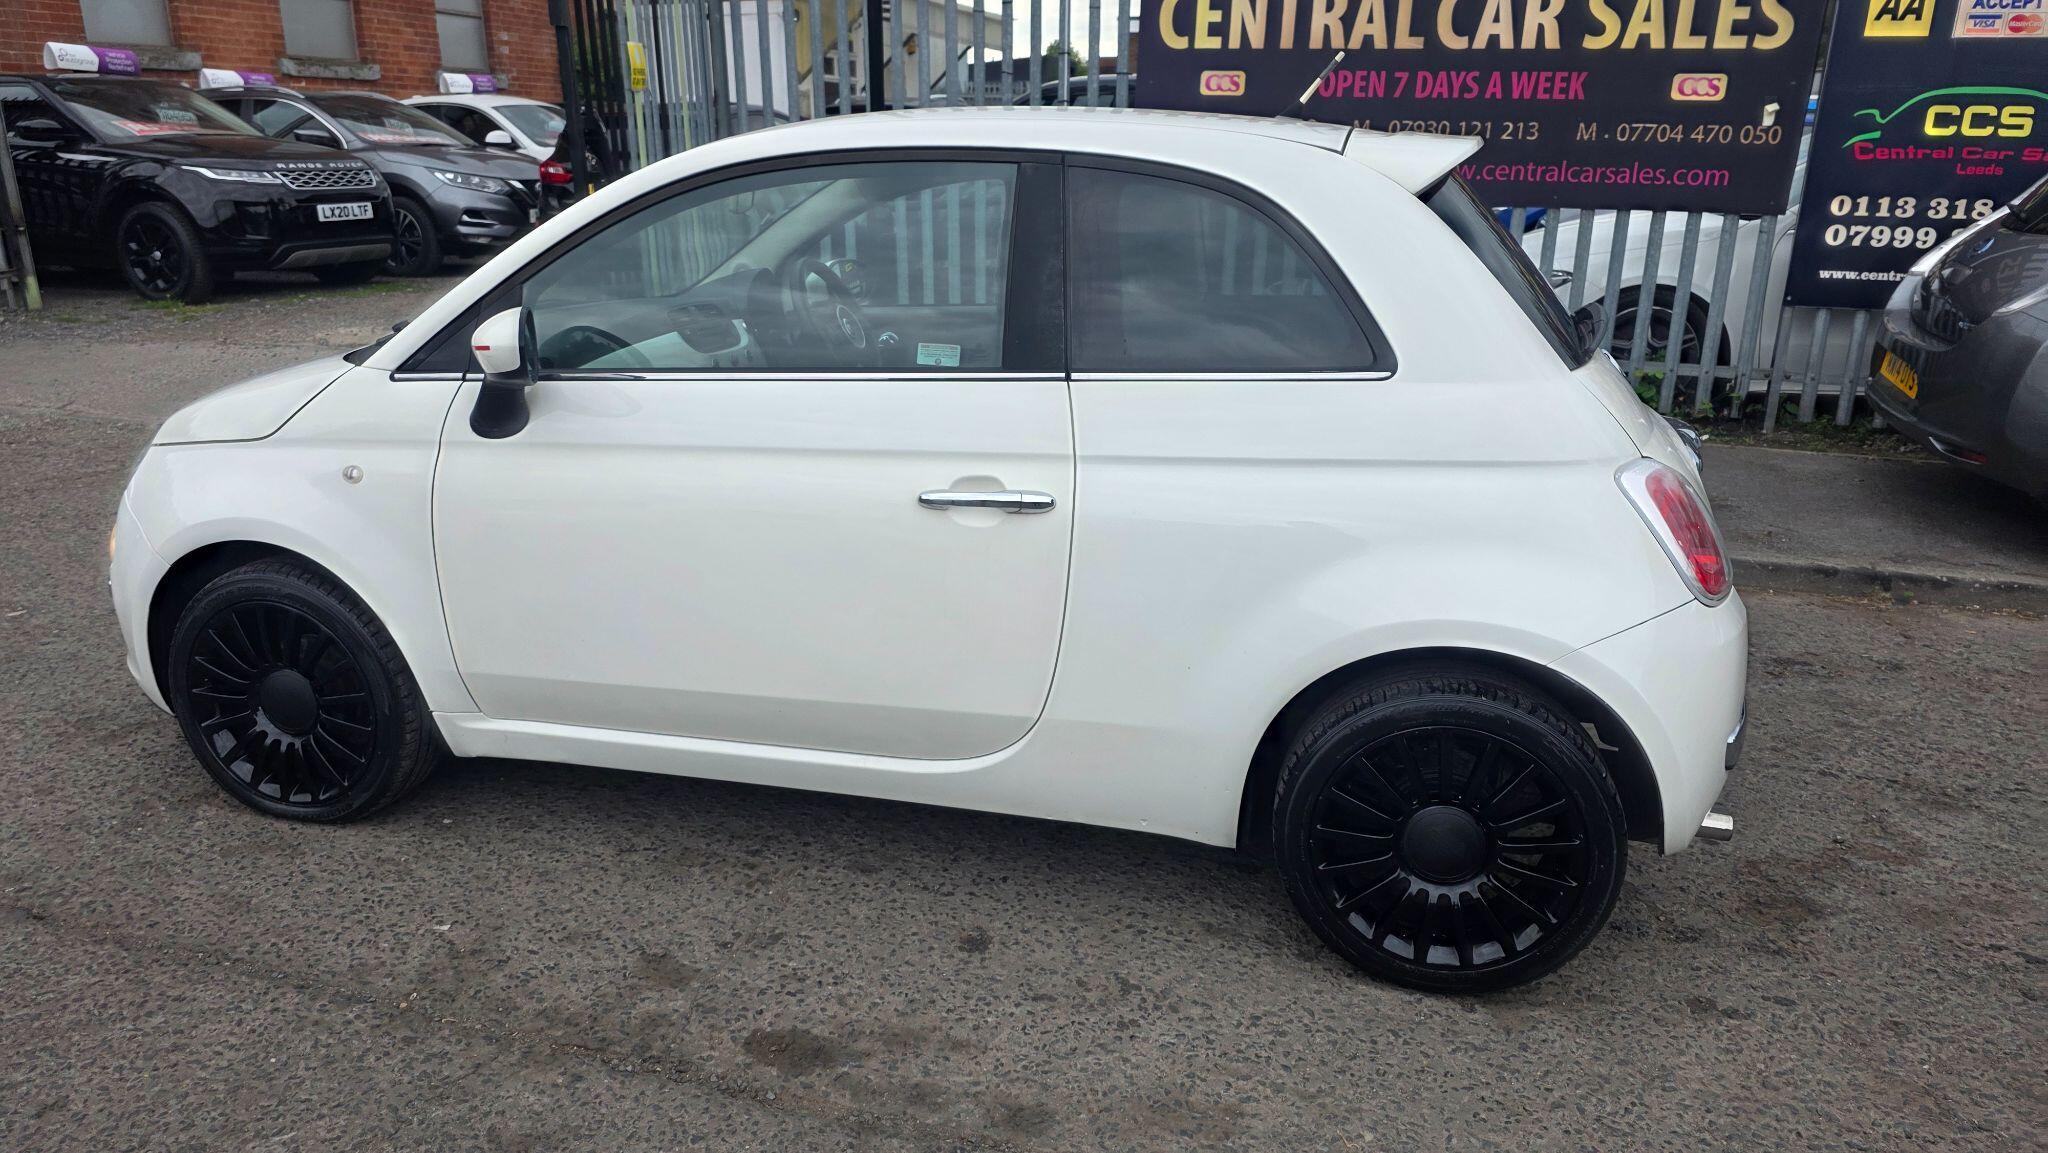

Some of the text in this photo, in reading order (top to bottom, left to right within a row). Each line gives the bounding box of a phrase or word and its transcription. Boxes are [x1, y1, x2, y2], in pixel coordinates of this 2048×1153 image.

[1159, 0, 1795, 49] CENTRAL CAR SALES
[1973, 20, 1996, 28] VISA
[1204, 74, 1241, 93] CCS
[1319, 70, 1589, 100] OPEN 7 DAYS A WEEK
[1677, 77, 1722, 97] CCS
[1459, 121, 1492, 138] 121
[1500, 121, 1540, 140] 213
[1924, 105, 2035, 137] CCS
[1616, 124, 1684, 143] 07704
[1690, 125, 1733, 144] 470
[1740, 126, 1783, 145] 050
[1854, 142, 1953, 160] Central
[1961, 147, 2014, 160] Car
[1957, 163, 2004, 176] Leeds
[322, 204, 369, 219] LX20 LTF
[1830, 195, 1994, 221] 0113 318
[1825, 224, 1937, 249] 07999
